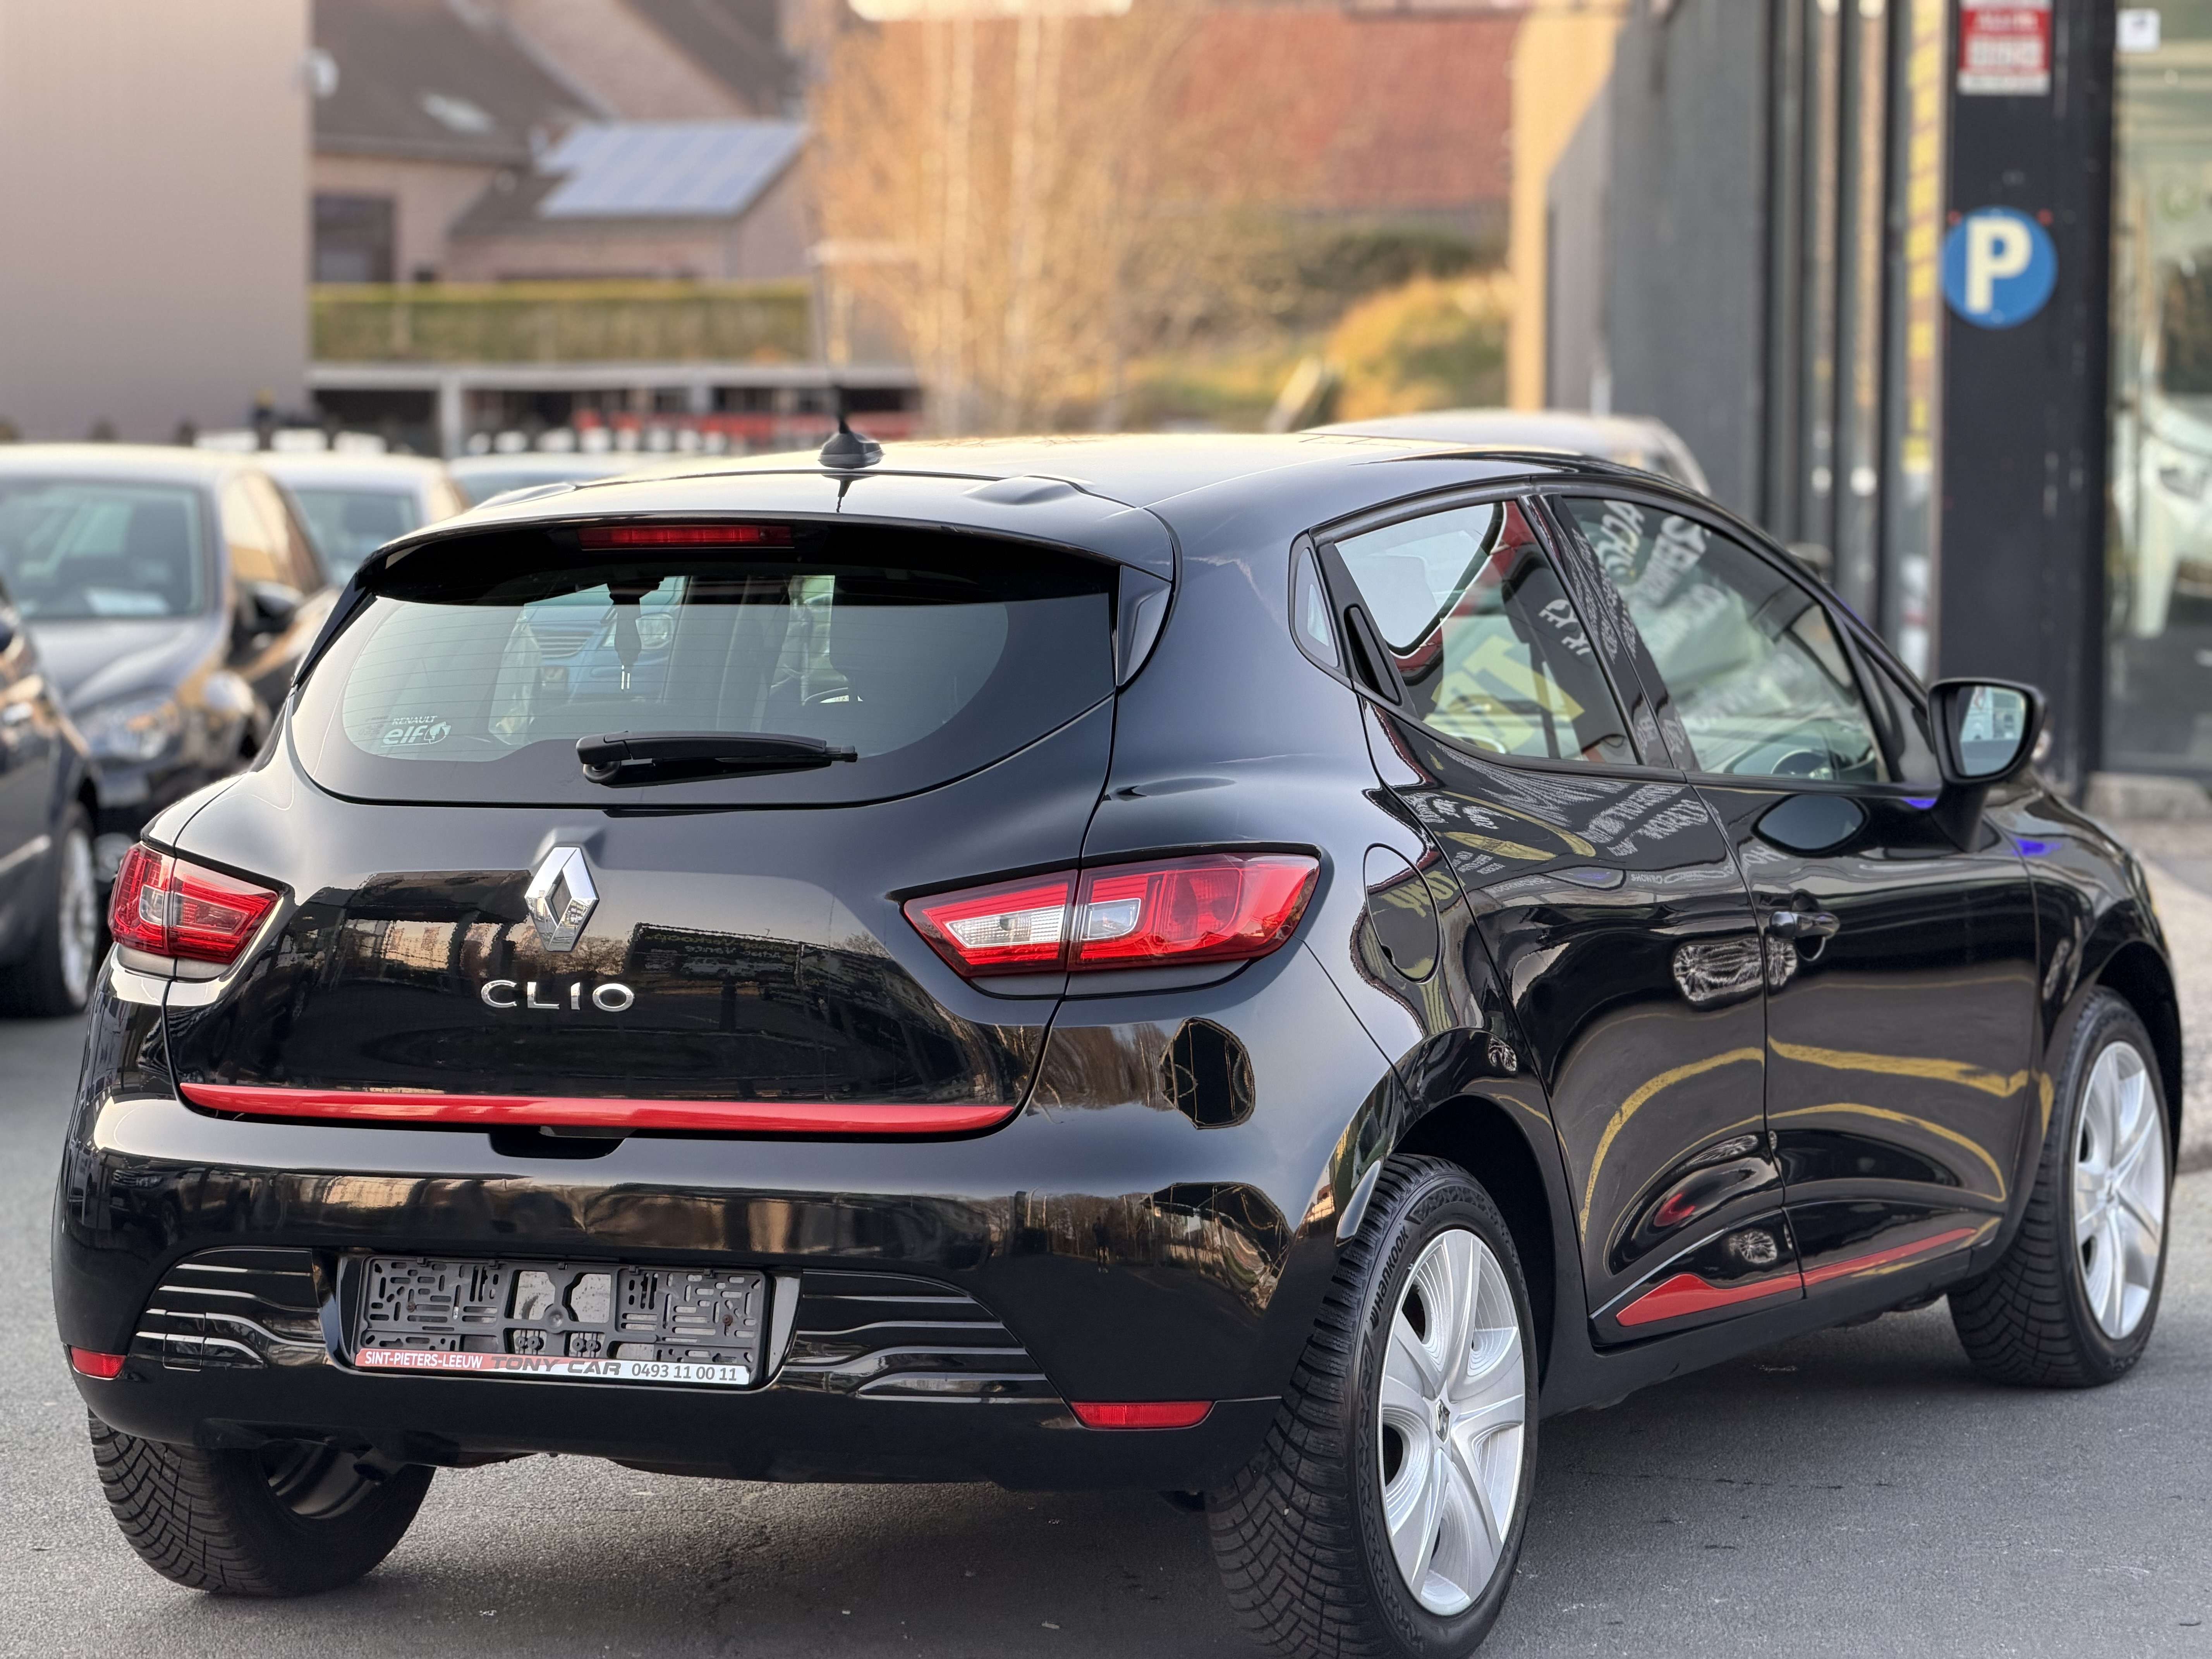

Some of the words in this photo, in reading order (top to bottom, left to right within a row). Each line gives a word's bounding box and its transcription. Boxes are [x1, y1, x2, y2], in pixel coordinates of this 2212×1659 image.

[1966, 216, 2033, 314] P
[383, 725, 428, 744] elf
[392, 716, 438, 725] RENAULT
[481, 980, 635, 1012] CLIO
[365, 1351, 483, 1369] SINT-PIETERS-LEEUW
[491, 1356, 560, 1372] TONY
[567, 1360, 622, 1375] CAR
[632, 1363, 669, 1377] 0493
[673, 1365, 691, 1379] 11
[696, 1366, 715, 1380] 00
[719, 1367, 737, 1381] 11
